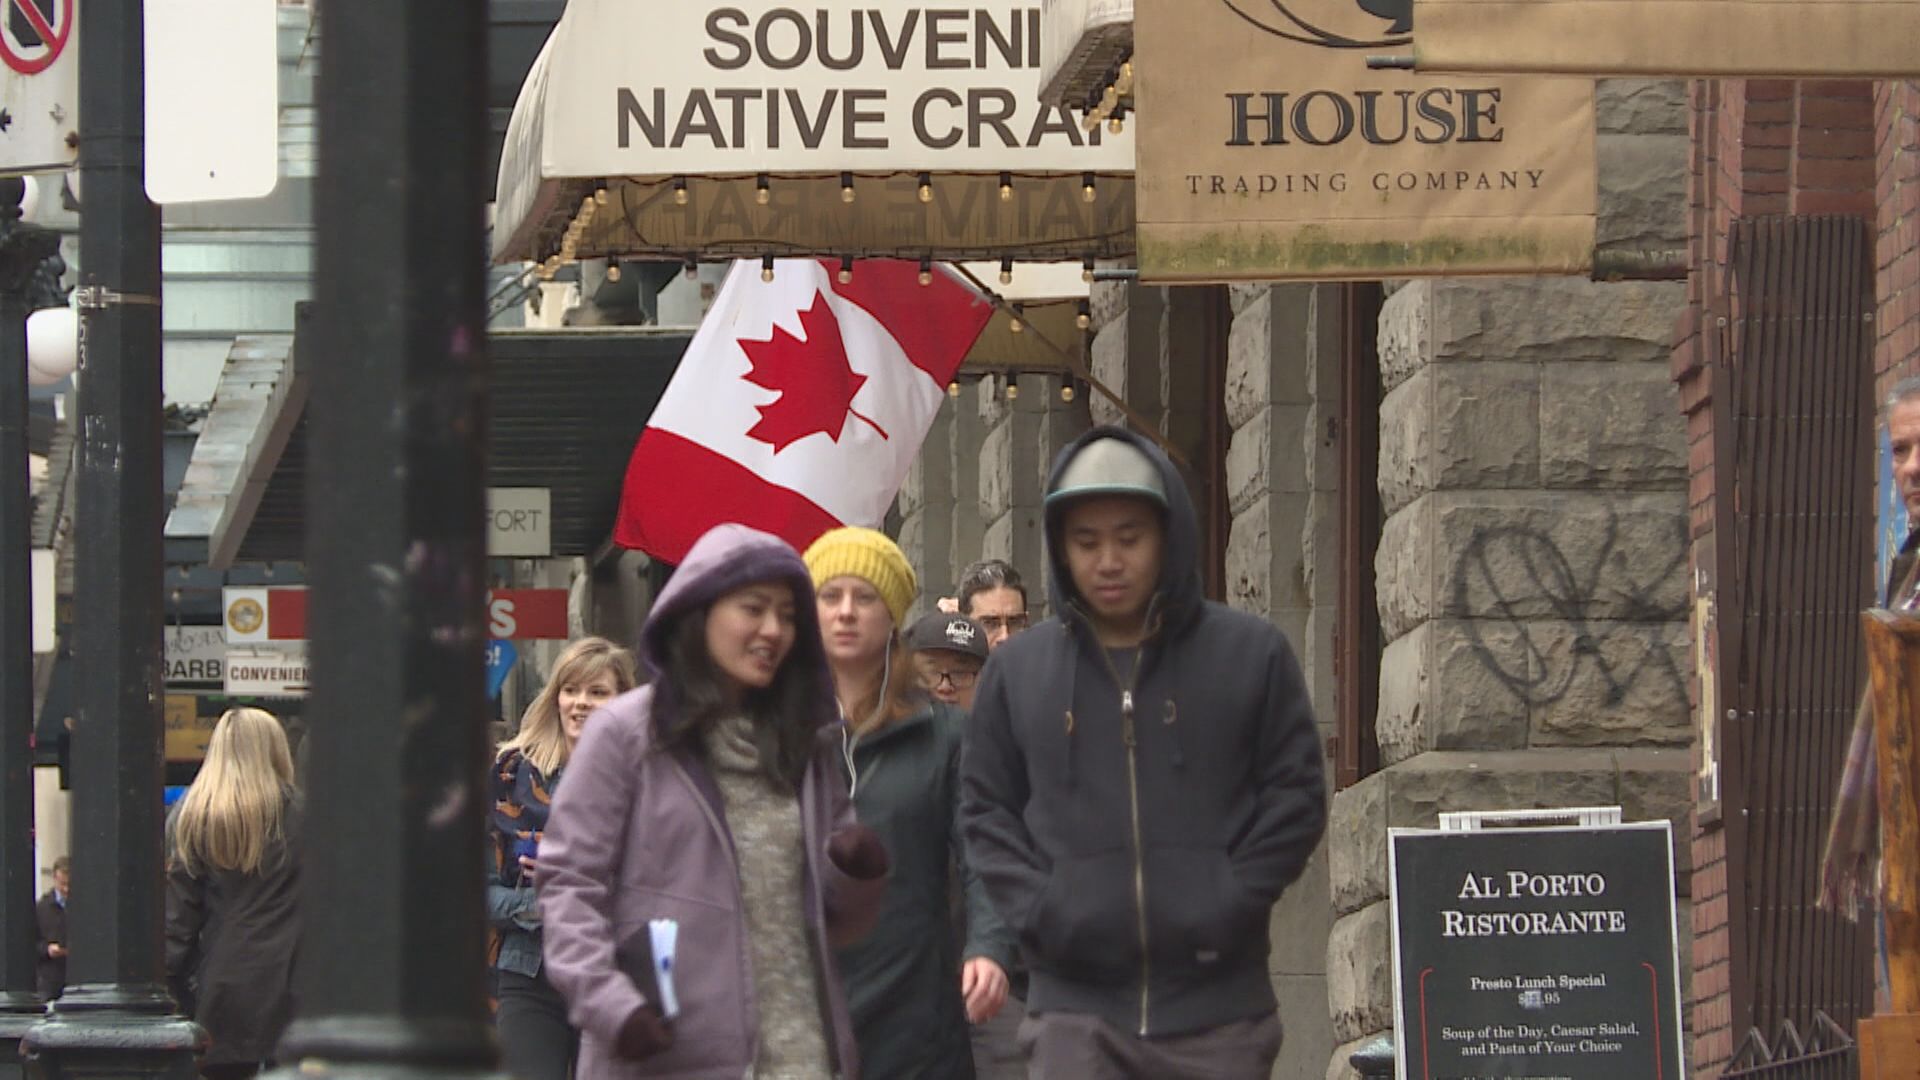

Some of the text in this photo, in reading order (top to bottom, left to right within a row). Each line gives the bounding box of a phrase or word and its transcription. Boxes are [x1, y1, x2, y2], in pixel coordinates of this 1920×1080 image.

[703, 8, 1041, 69] SOUVENI
[617, 88, 888, 149] NATIVE
[1225, 87, 1504, 147] HOUSE
[1186, 169, 1545, 195] TRADING COMPANY
[1458, 871, 1605, 898] AL PORTO
[1442, 911, 1626, 937] RISTORANTE
[1471, 973, 1606, 991] Presto Lunch Special
[1442, 1027, 1475, 1041] Soup
[1478, 1026, 1491, 1039] of
[1494, 1025, 1514, 1038] the
[1551, 1024, 1596, 1038] Caesar
[1599, 1022, 1640, 1037] Salad,
[1461, 1039, 1622, 1056] and Pasta of Your Choice
